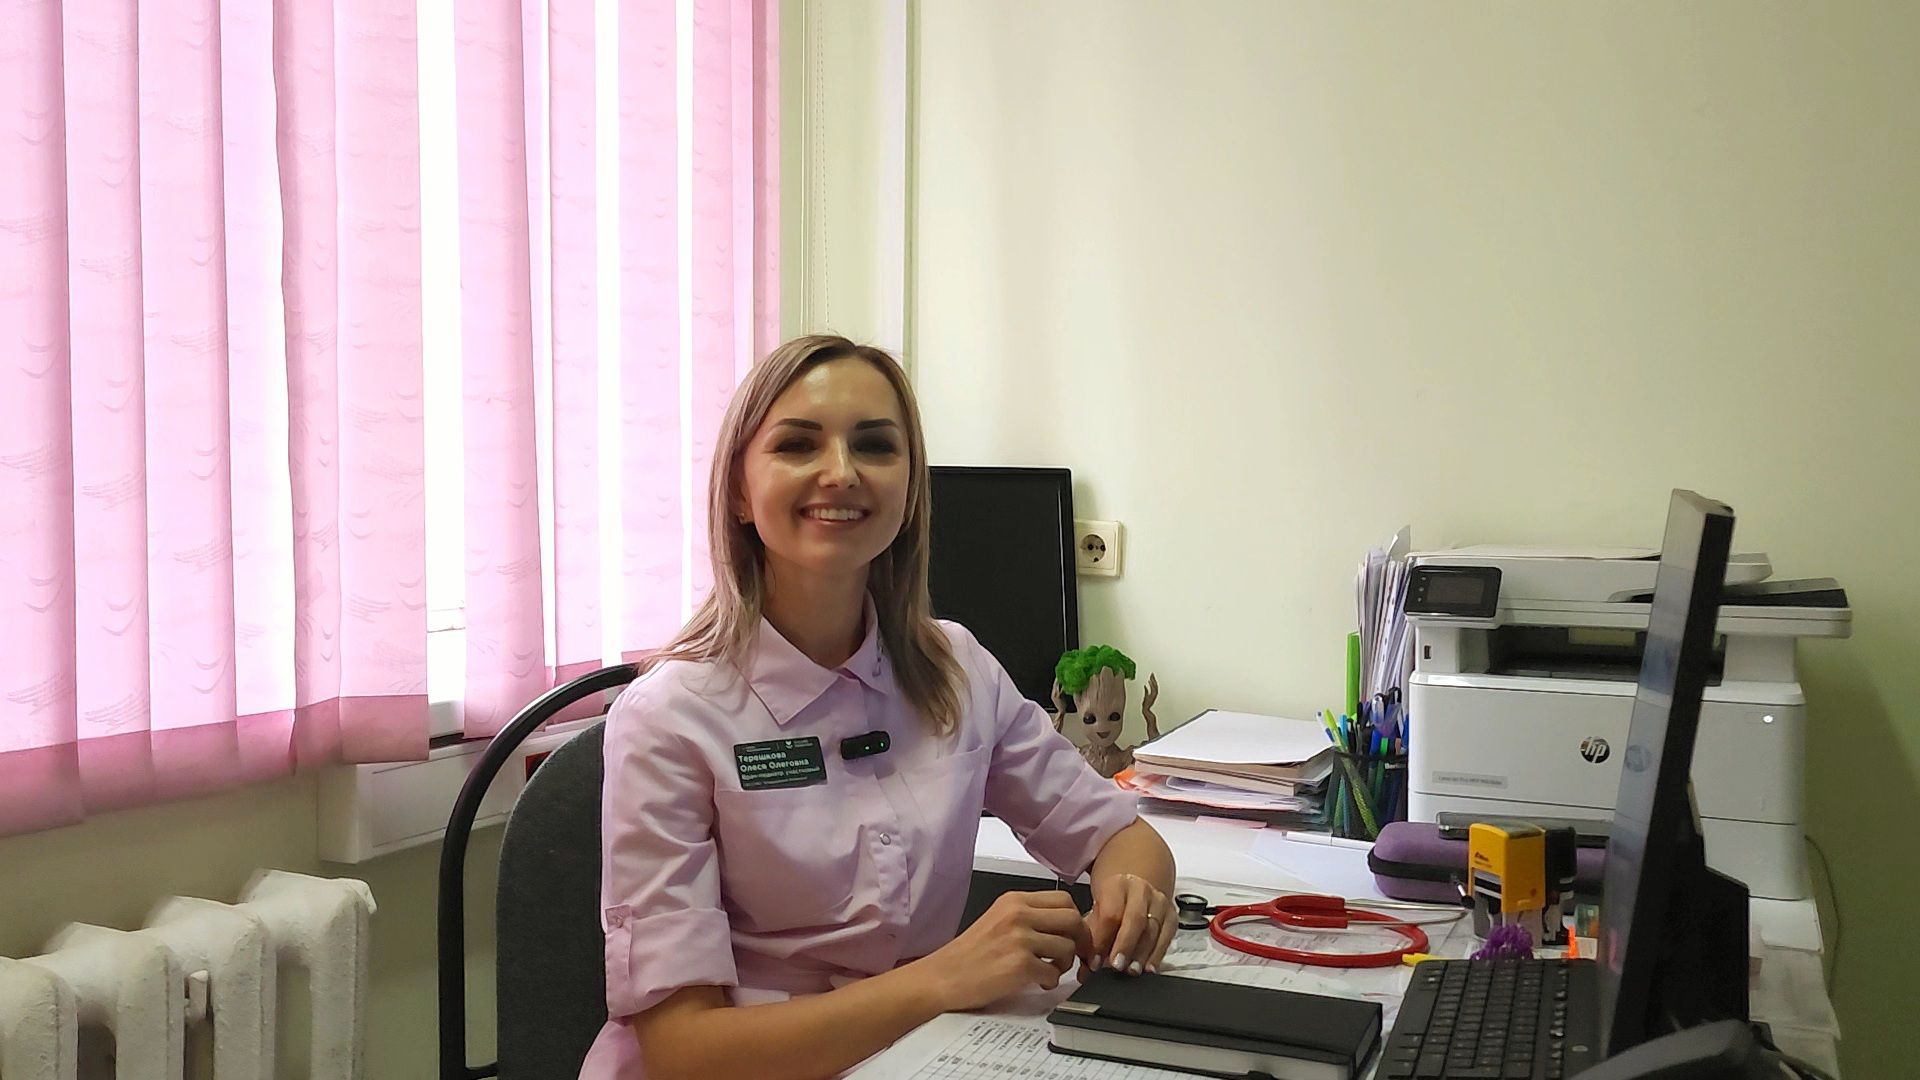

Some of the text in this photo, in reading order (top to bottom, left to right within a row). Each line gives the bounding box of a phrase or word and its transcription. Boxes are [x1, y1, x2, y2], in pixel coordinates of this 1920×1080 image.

[1583, 736, 1608, 763] hp
[738, 752, 786, 763] Терешкова
[740, 759, 809, 773] Олеся Олеговна
